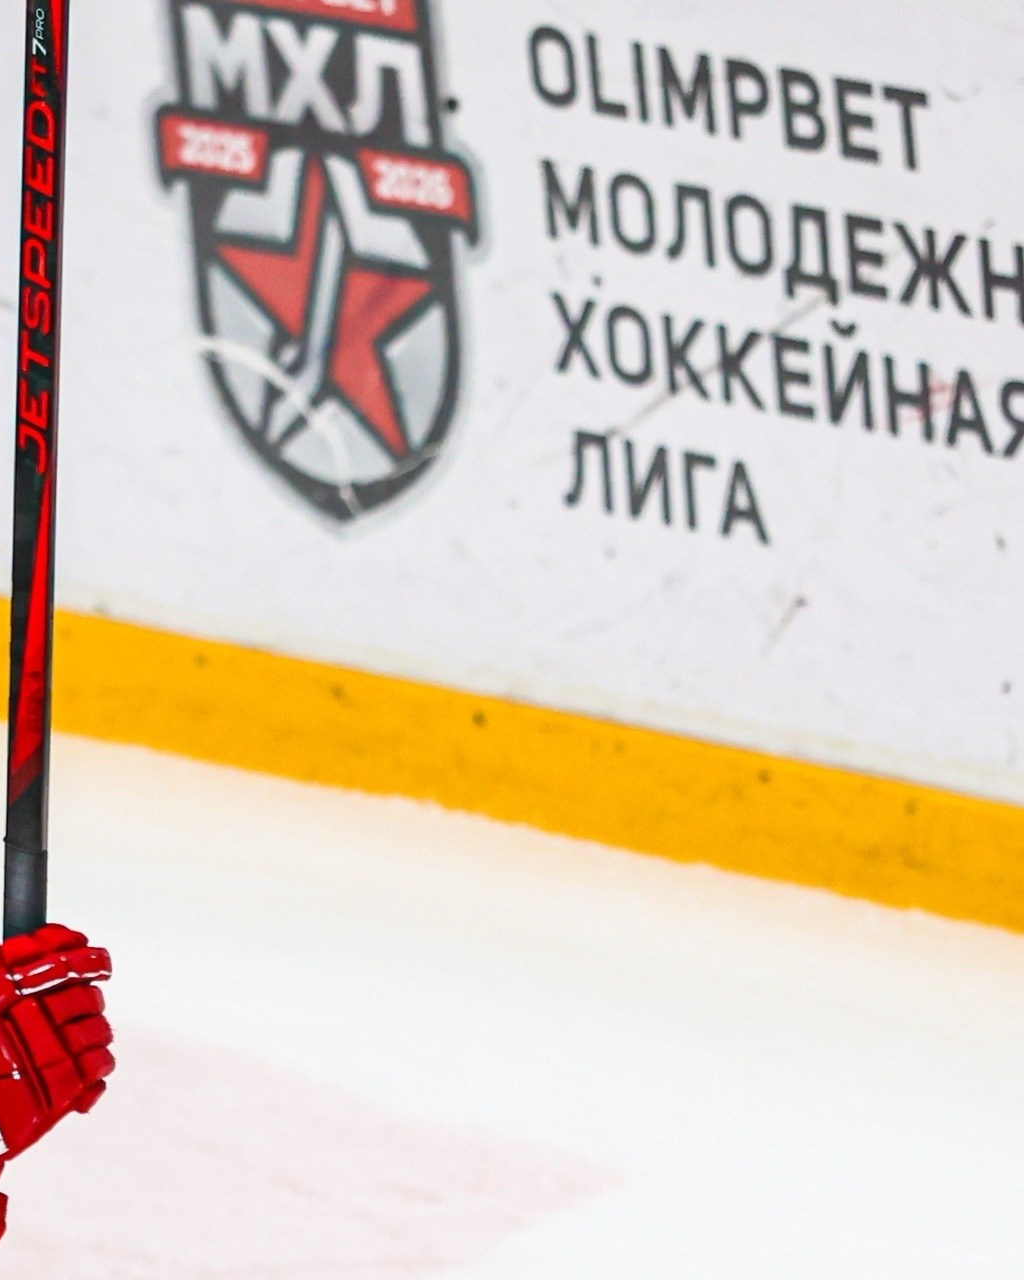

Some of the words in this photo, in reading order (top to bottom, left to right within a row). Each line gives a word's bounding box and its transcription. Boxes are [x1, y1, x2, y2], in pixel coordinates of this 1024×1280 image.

[181, 3, 432, 148] МХЛ
[528, 26, 929, 171] OLIMPBET
[18, 101, 56, 475] JETSPEED
[540, 157, 1024, 327] МОЛОДЕЖН
[563, 430, 769, 546] ЛИГА
